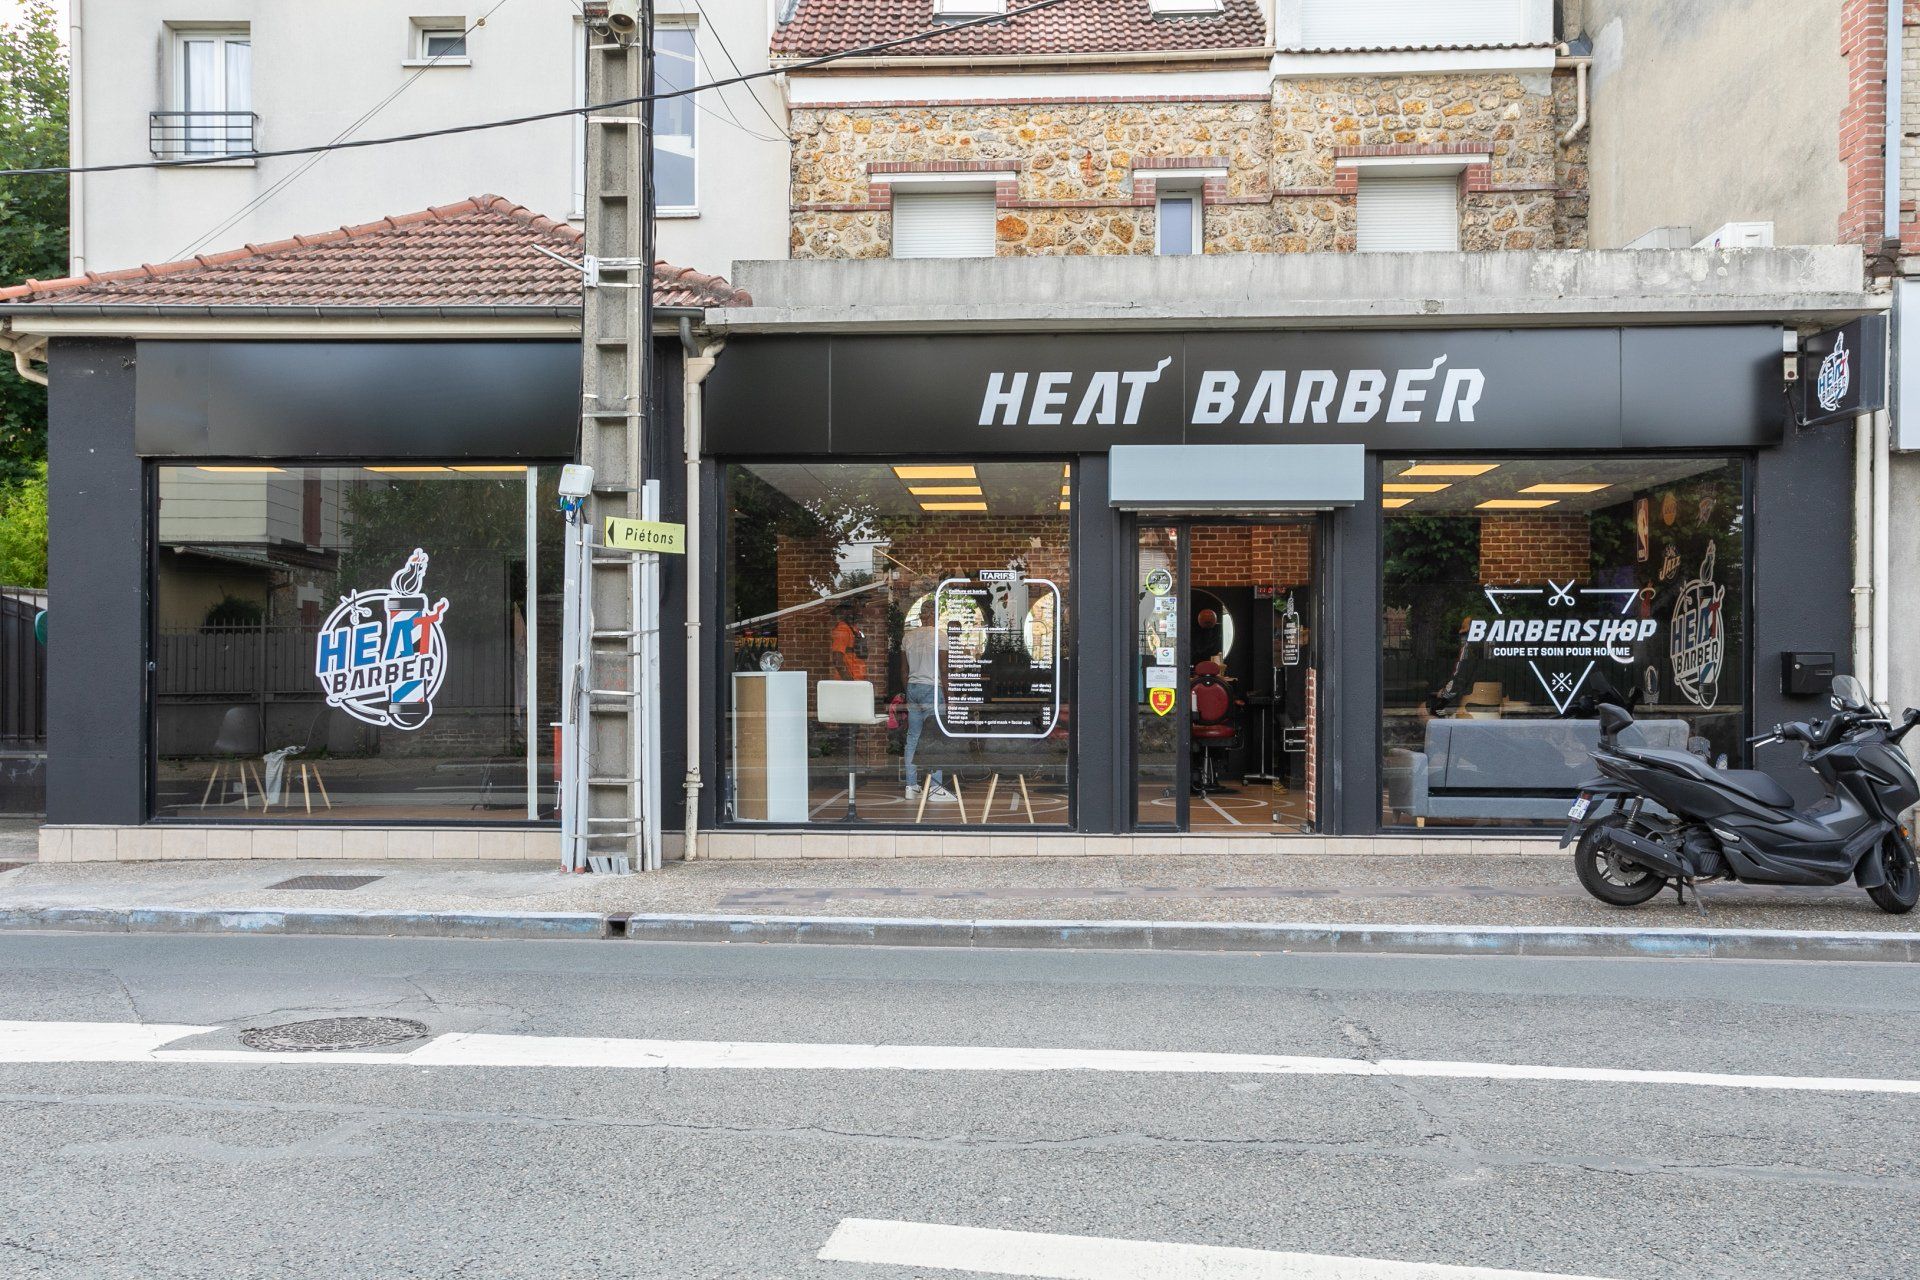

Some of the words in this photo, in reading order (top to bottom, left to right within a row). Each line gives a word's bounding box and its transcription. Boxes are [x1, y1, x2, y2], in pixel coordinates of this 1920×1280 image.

[979, 355, 1172, 425] HEAT
[1191, 354, 1486, 424] BARBER
[1819, 358, 1848, 393] HEAT
[625, 527, 674, 545] Piétons
[982, 572, 1015, 580] TARIFS
[319, 603, 446, 674] HEAT
[1467, 619, 1657, 642] BARBERSHOP
[1672, 600, 1721, 654] HEAT
[1493, 647, 1526, 656] COUPE
[1527, 647, 1539, 656] ET
[1541, 647, 1564, 656] SOIN
[1566, 647, 1592, 656] POUR
[1593, 647, 1630, 656] HOMME
[1676, 641, 1719, 675] BARBER
[333, 657, 435, 694] BARBER
